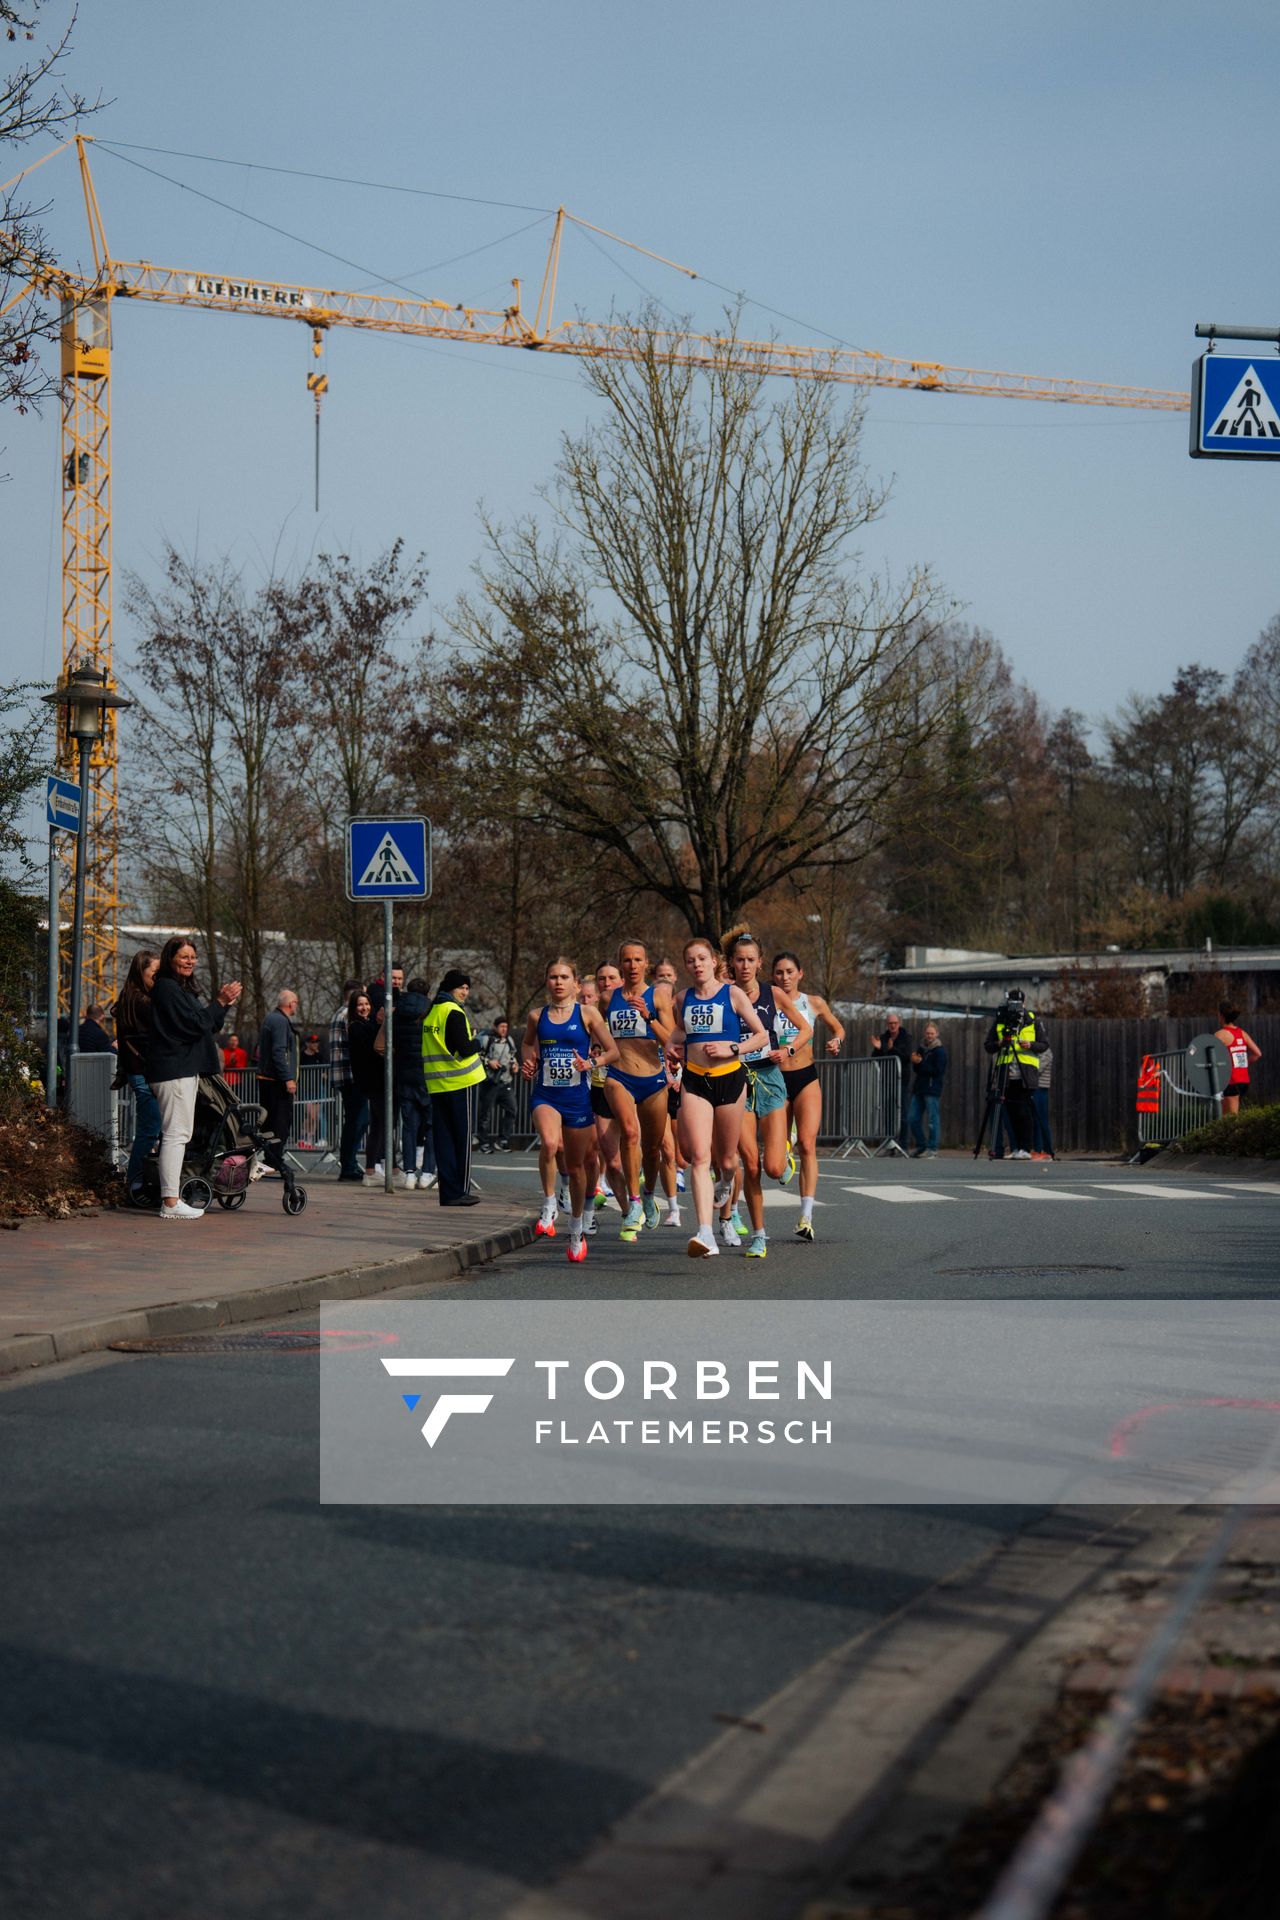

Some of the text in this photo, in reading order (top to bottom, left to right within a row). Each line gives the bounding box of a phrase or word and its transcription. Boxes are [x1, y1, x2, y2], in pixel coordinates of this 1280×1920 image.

[197, 279, 304, 306] LIEBHERR
[617, 1010, 637, 1019] GLS
[691, 1005, 713, 1014] GLS
[617, 1020, 637, 1030] 227
[691, 1015, 714, 1026] 930
[549, 1059, 572, 1068] GLS
[550, 1068, 573, 1080] 933
